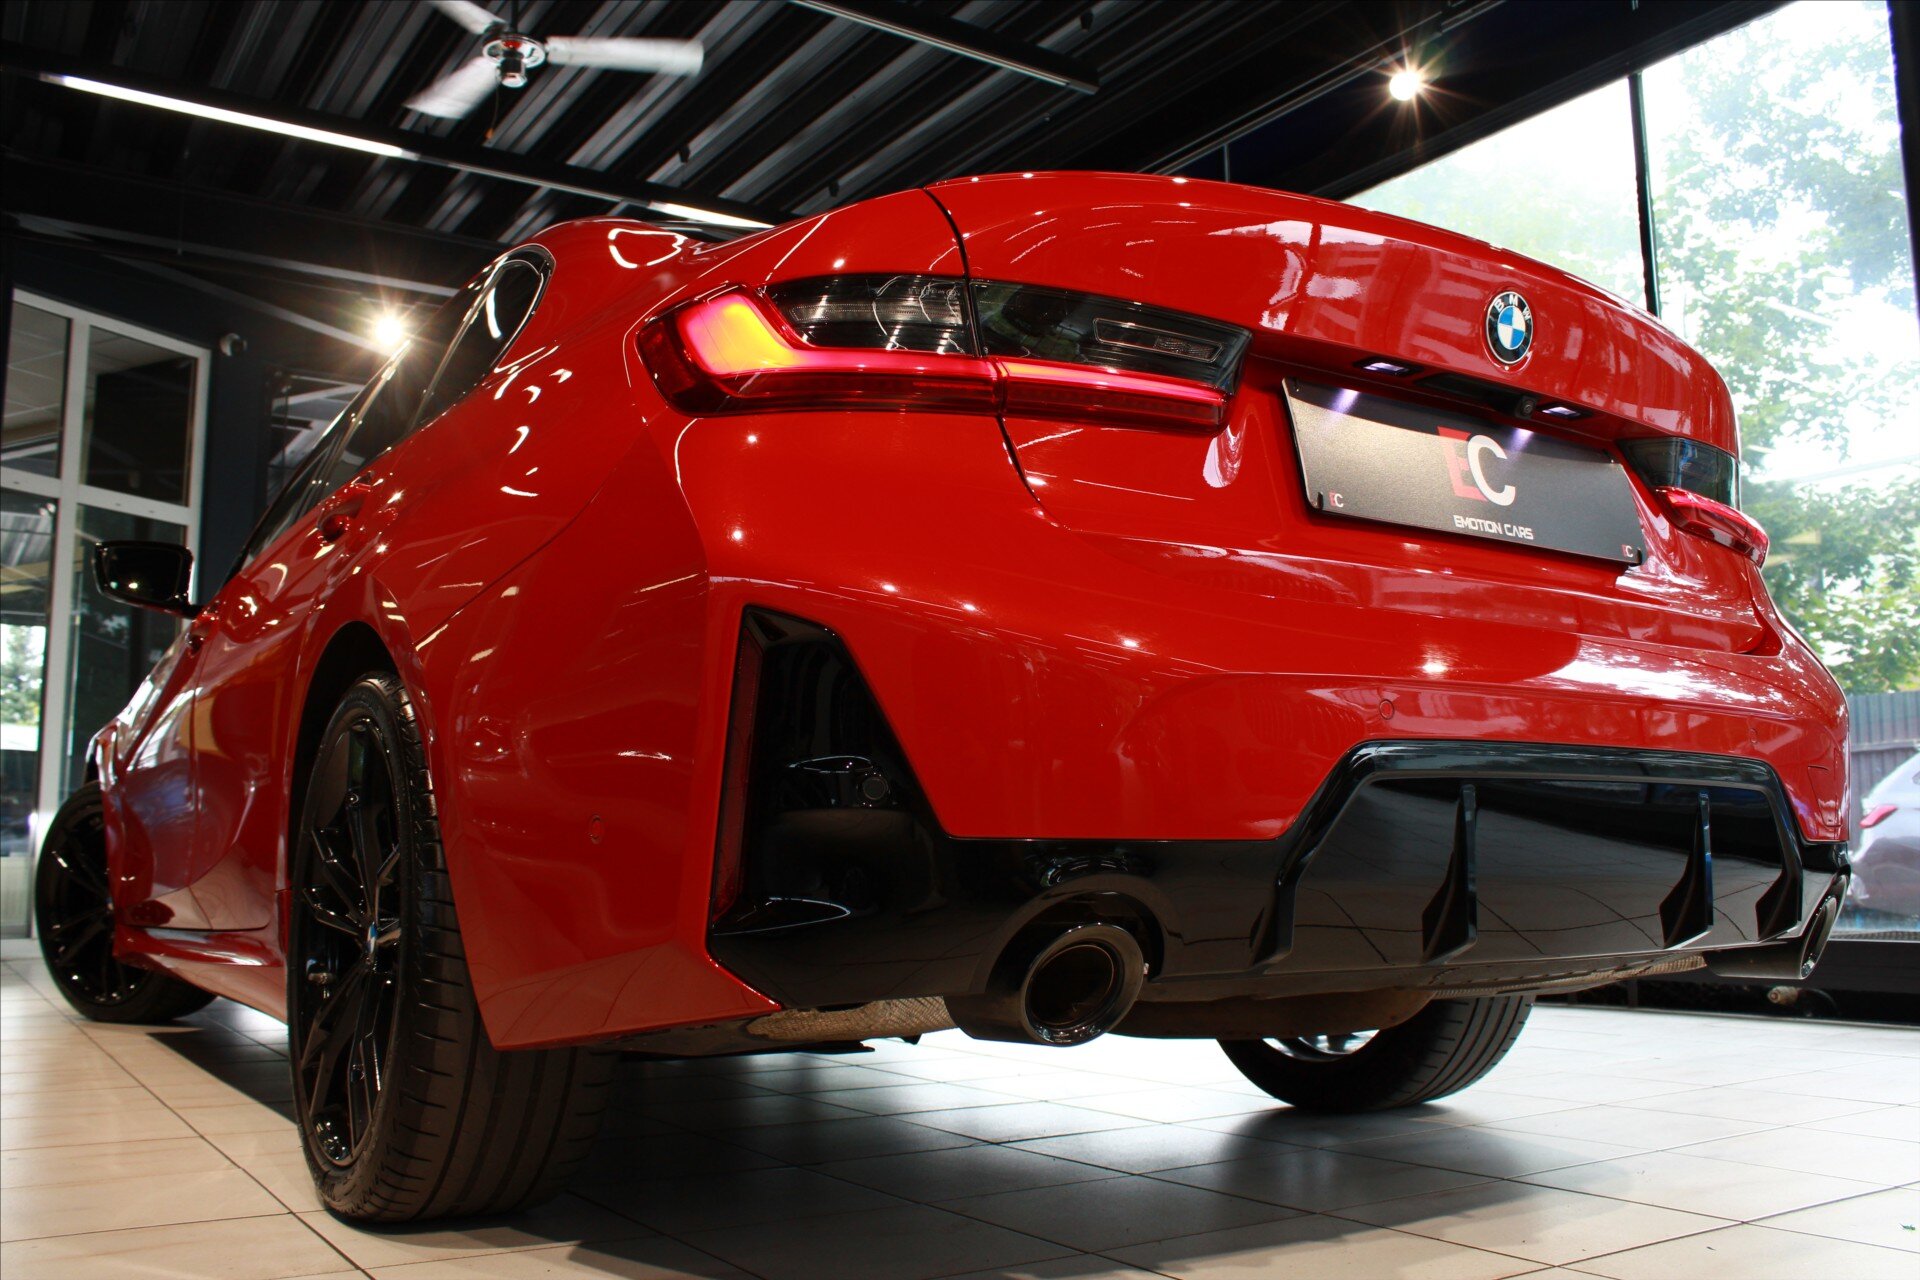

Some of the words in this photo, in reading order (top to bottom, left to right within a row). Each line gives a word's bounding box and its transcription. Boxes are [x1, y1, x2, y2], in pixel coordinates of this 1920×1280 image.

[1494, 294, 1531, 320] BMW
[1437, 426, 1516, 506] EC
[1453, 514, 1503, 534] EMOTION
[1503, 523, 1534, 540] CARS
